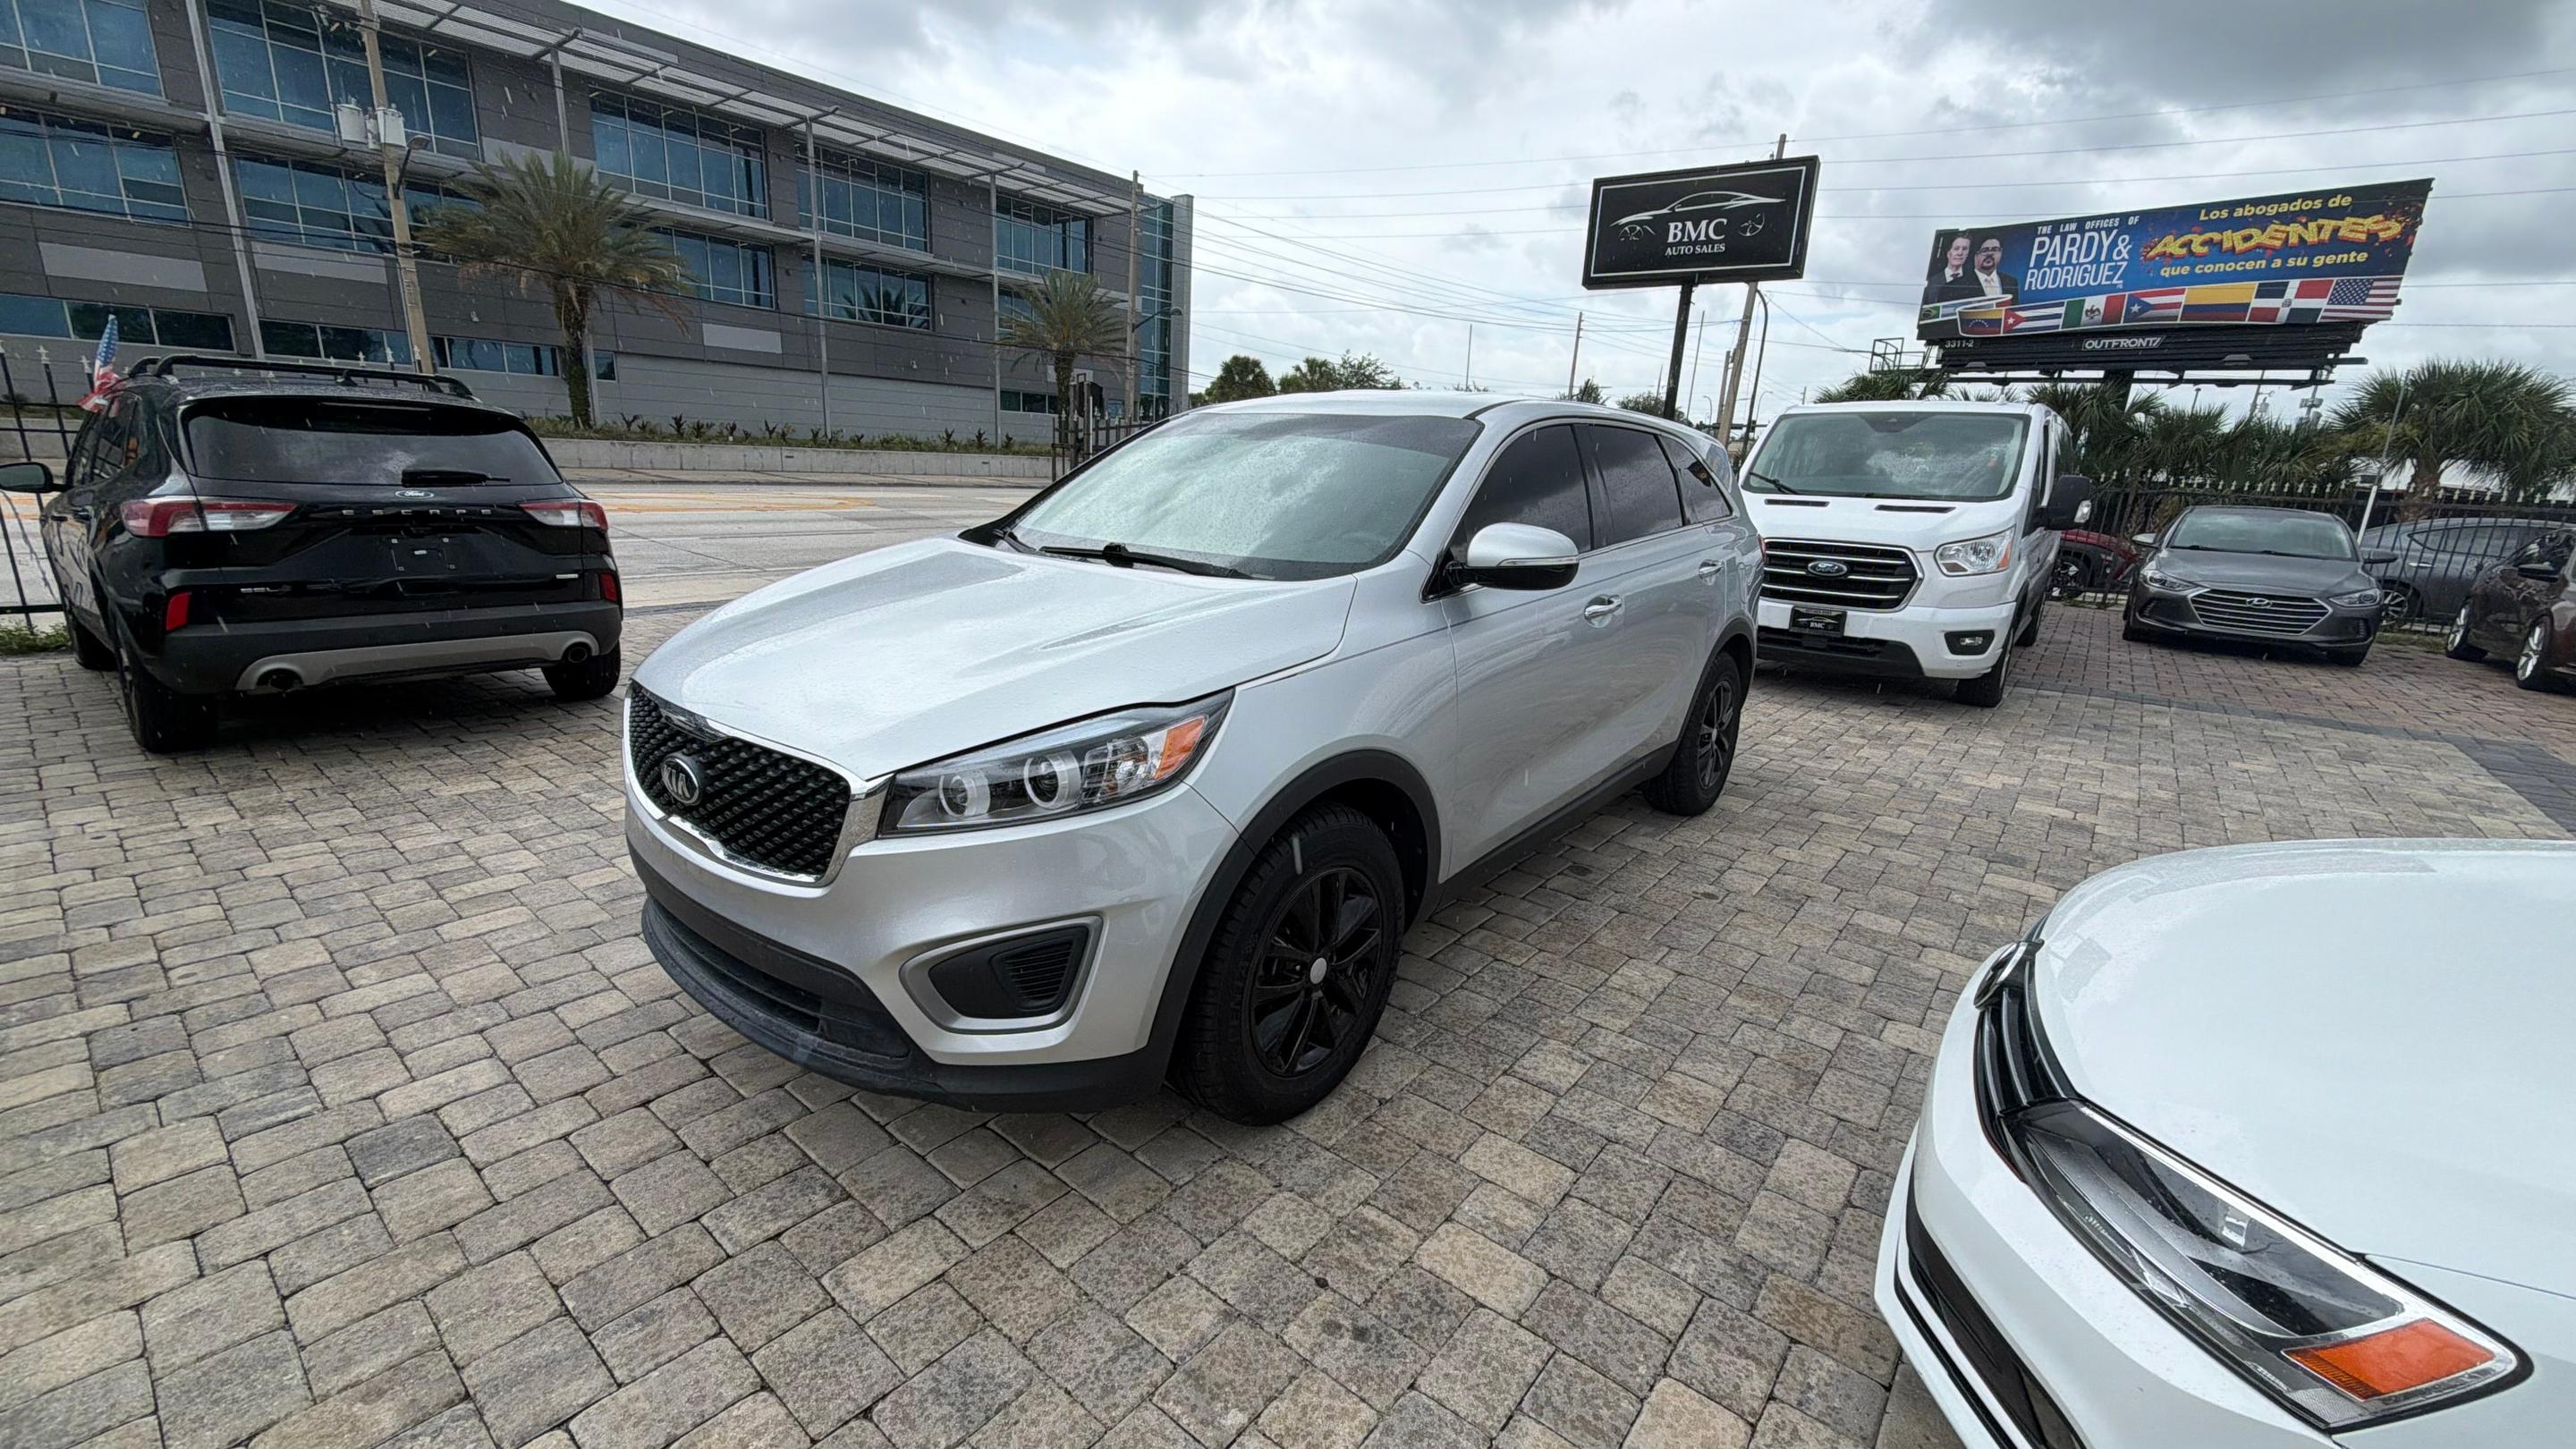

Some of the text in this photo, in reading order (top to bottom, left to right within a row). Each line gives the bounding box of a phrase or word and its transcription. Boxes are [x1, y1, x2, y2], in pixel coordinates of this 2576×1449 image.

[2199, 194, 2352, 221] Los abogados de
[1666, 218, 1728, 243] BMC
[2038, 216, 2140, 235] THE LAW OFFICES OF
[2147, 214, 2402, 259] ACCIDENTES
[1665, 243, 1725, 256] AUTO SALES
[2024, 261, 2129, 291] RODRIGUEZ
[2160, 250, 2368, 278] que conocen a su gente
[1945, 339, 1974, 348] 3311-2
[662, 764, 691, 799] KIA
